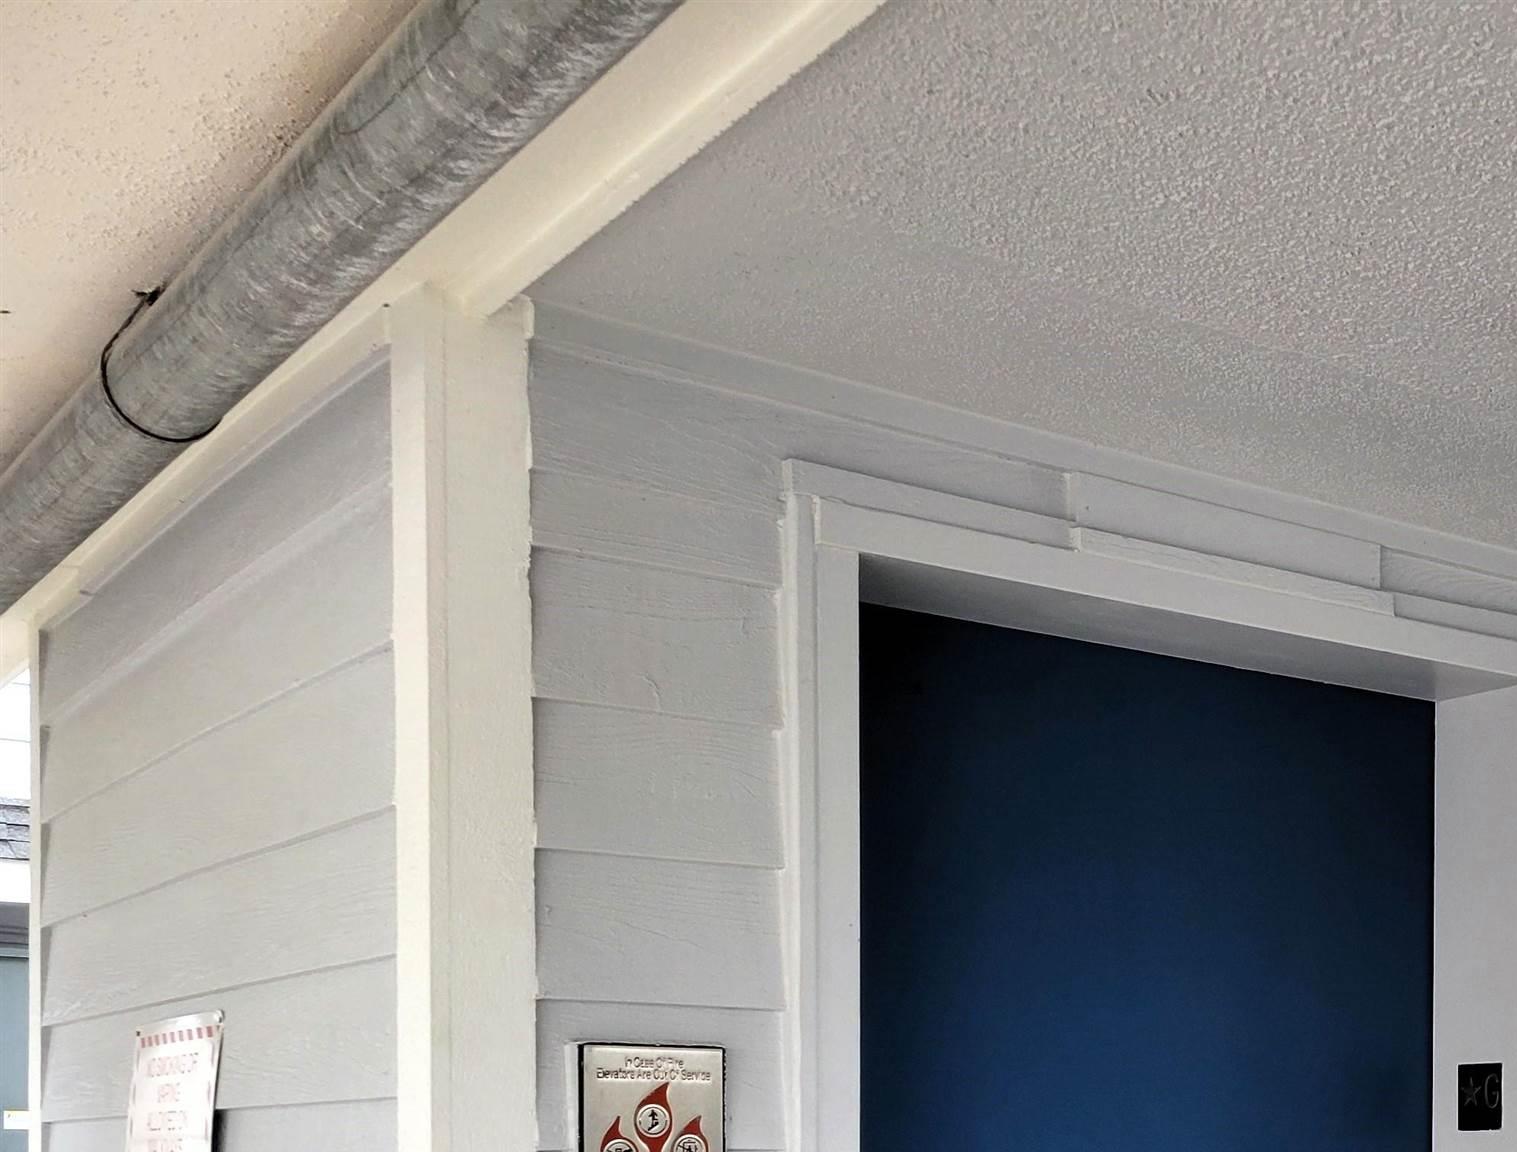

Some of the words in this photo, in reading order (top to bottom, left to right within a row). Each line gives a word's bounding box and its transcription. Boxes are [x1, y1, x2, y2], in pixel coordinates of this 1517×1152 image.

[596, 1067, 636, 1079] Elevators
[637, 1069, 651, 1079] Are
[681, 1069, 711, 1081] Service
